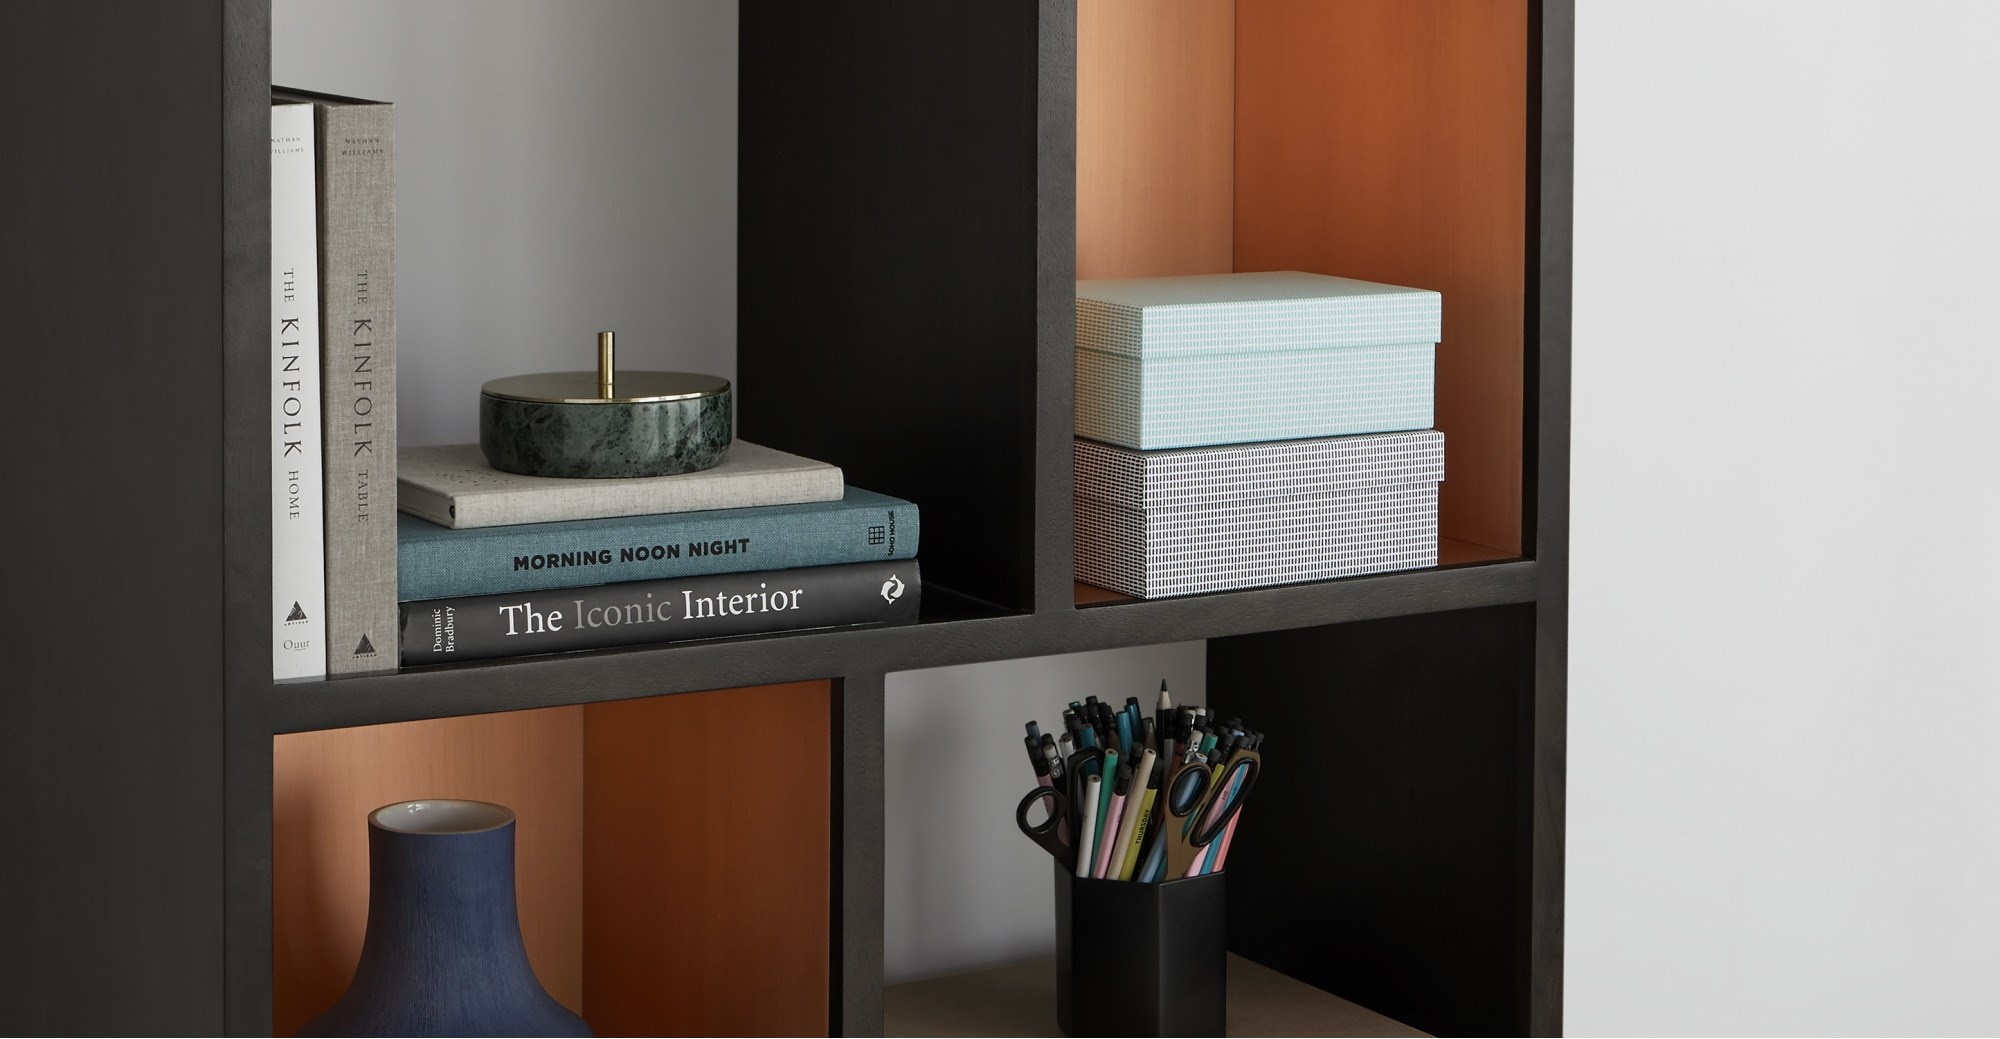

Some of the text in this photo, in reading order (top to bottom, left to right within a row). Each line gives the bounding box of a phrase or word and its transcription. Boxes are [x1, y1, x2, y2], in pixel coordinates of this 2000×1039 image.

[281, 268, 302, 520] THE KINFOLK HOME
[353, 270, 373, 522] THE KINFOLK TABLE
[513, 538, 750, 571] MORNING NOON NIGHT
[888, 511, 896, 556] SOHO HOUSE
[432, 608, 442, 652] Dominic
[445, 606, 456, 653] Bradbury
[499, 582, 803, 636] The Iconic Interior
[1135, 809, 1150, 845] THURSDAY
